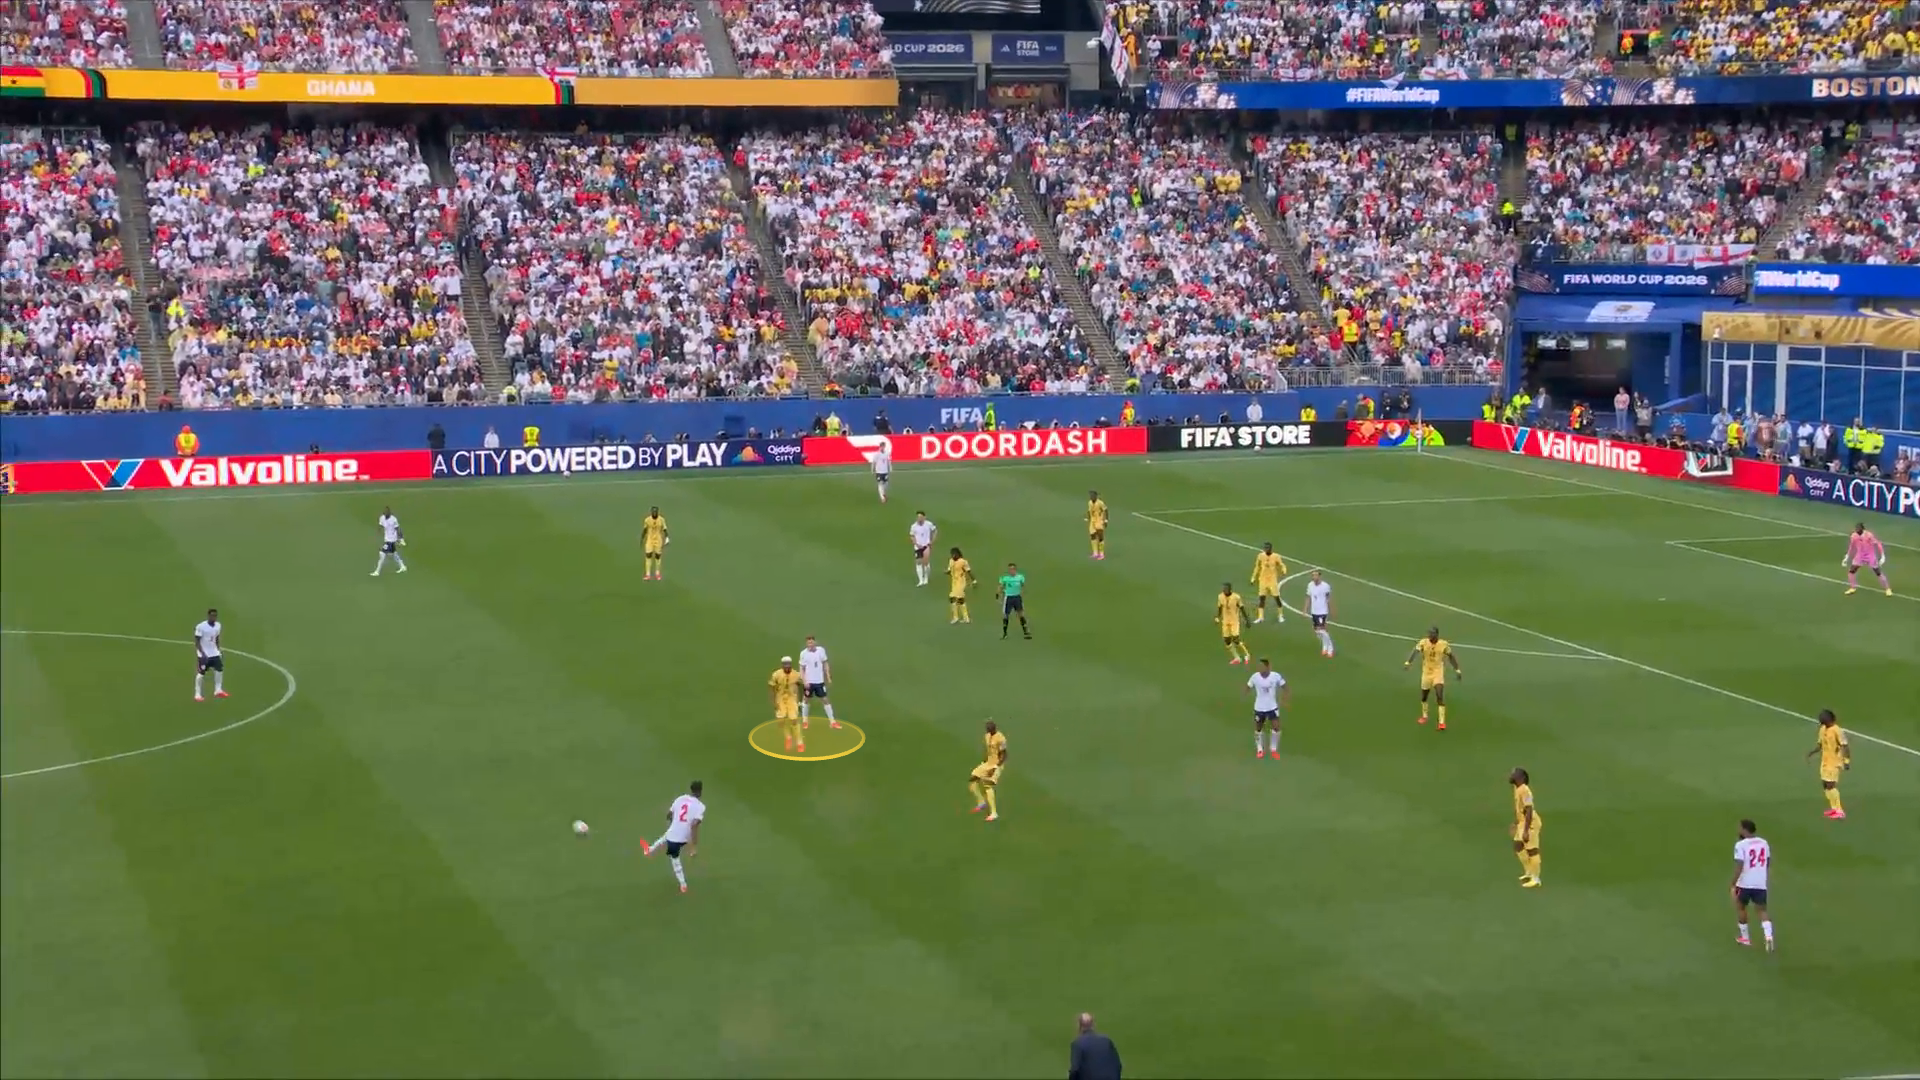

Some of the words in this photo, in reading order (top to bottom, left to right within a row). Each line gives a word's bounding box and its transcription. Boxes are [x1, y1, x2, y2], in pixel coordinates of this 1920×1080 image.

[904, 43, 925, 53] CUP
[927, 43, 965, 53] 2026
[1016, 40, 1039, 50] FIFA
[307, 80, 376, 96] GHANA
[1812, 76, 1920, 98] BOSTON
[1563, 274, 1590, 284] FIFA
[1591, 274, 1637, 284] WORLD
[1638, 274, 1663, 284] CUP
[1664, 275, 1708, 285] 2026
[940, 408, 984, 424] FIFA
[920, 430, 1107, 460] DOORDASH
[1180, 427, 1234, 448] FIFA
[1237, 424, 1311, 446] STORE
[432, 453, 448, 474] A
[451, 449, 508, 476] CITY
[510, 445, 636, 473] POWERED
[638, 447, 663, 466] BY
[665, 442, 728, 468] PLAY
[775, 455, 794, 464] CITY
[1537, 430, 1642, 472] Valvoline
[158, 455, 360, 487] Valvoline
[1832, 479, 1846, 501] A
[1849, 478, 1898, 511] CITY
[679, 803, 689, 822] 2
[1748, 847, 1766, 868] 24
